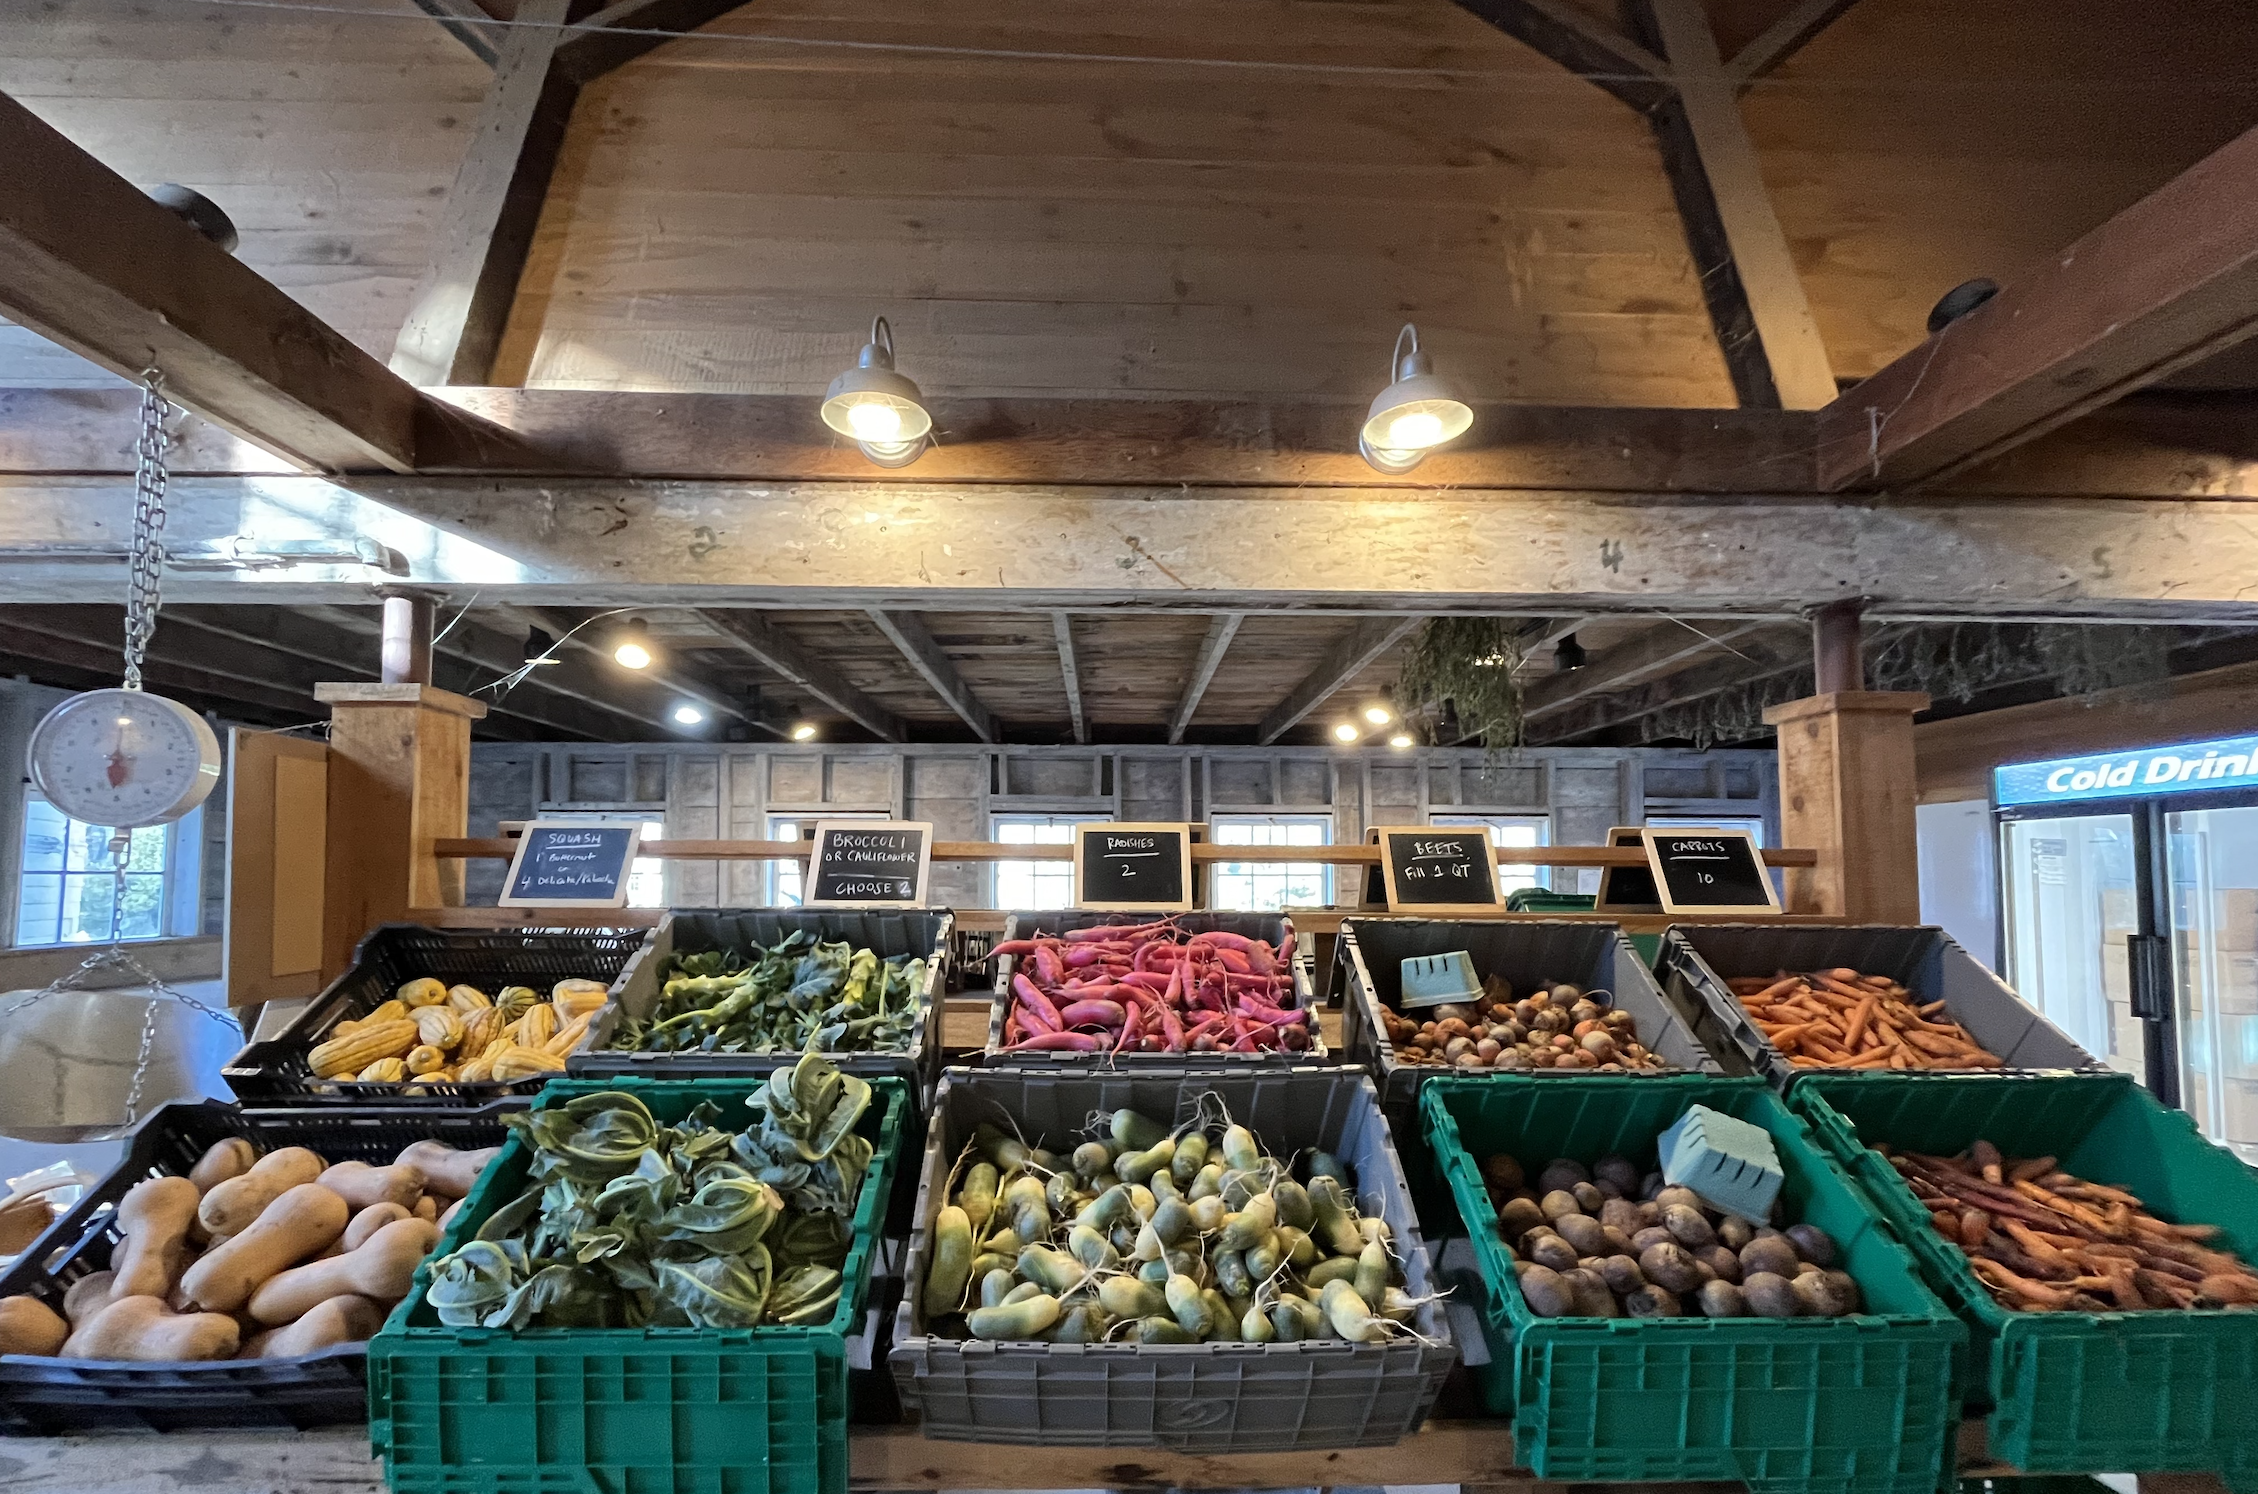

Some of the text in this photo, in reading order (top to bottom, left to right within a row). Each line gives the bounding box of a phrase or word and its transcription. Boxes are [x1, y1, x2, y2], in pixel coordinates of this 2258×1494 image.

[2047, 760, 2139, 793] Cold
[549, 833, 601, 844] SQUASH
[833, 833, 906, 849] BROCCOLI
[1107, 837, 1154, 850] RADISHES
[1413, 841, 1463, 855] BEETS
[1671, 840, 1725, 852] CARROTS
[825, 849, 916, 863] OR CAULIFLOWER
[1121, 864, 1137, 876] 2
[1434, 864, 1444, 877] 1
[1451, 862, 1471, 878] QT
[521, 876, 531, 890] 4
[1697, 872, 1714, 884] 10
[835, 881, 912, 896] CHOOSE 2
